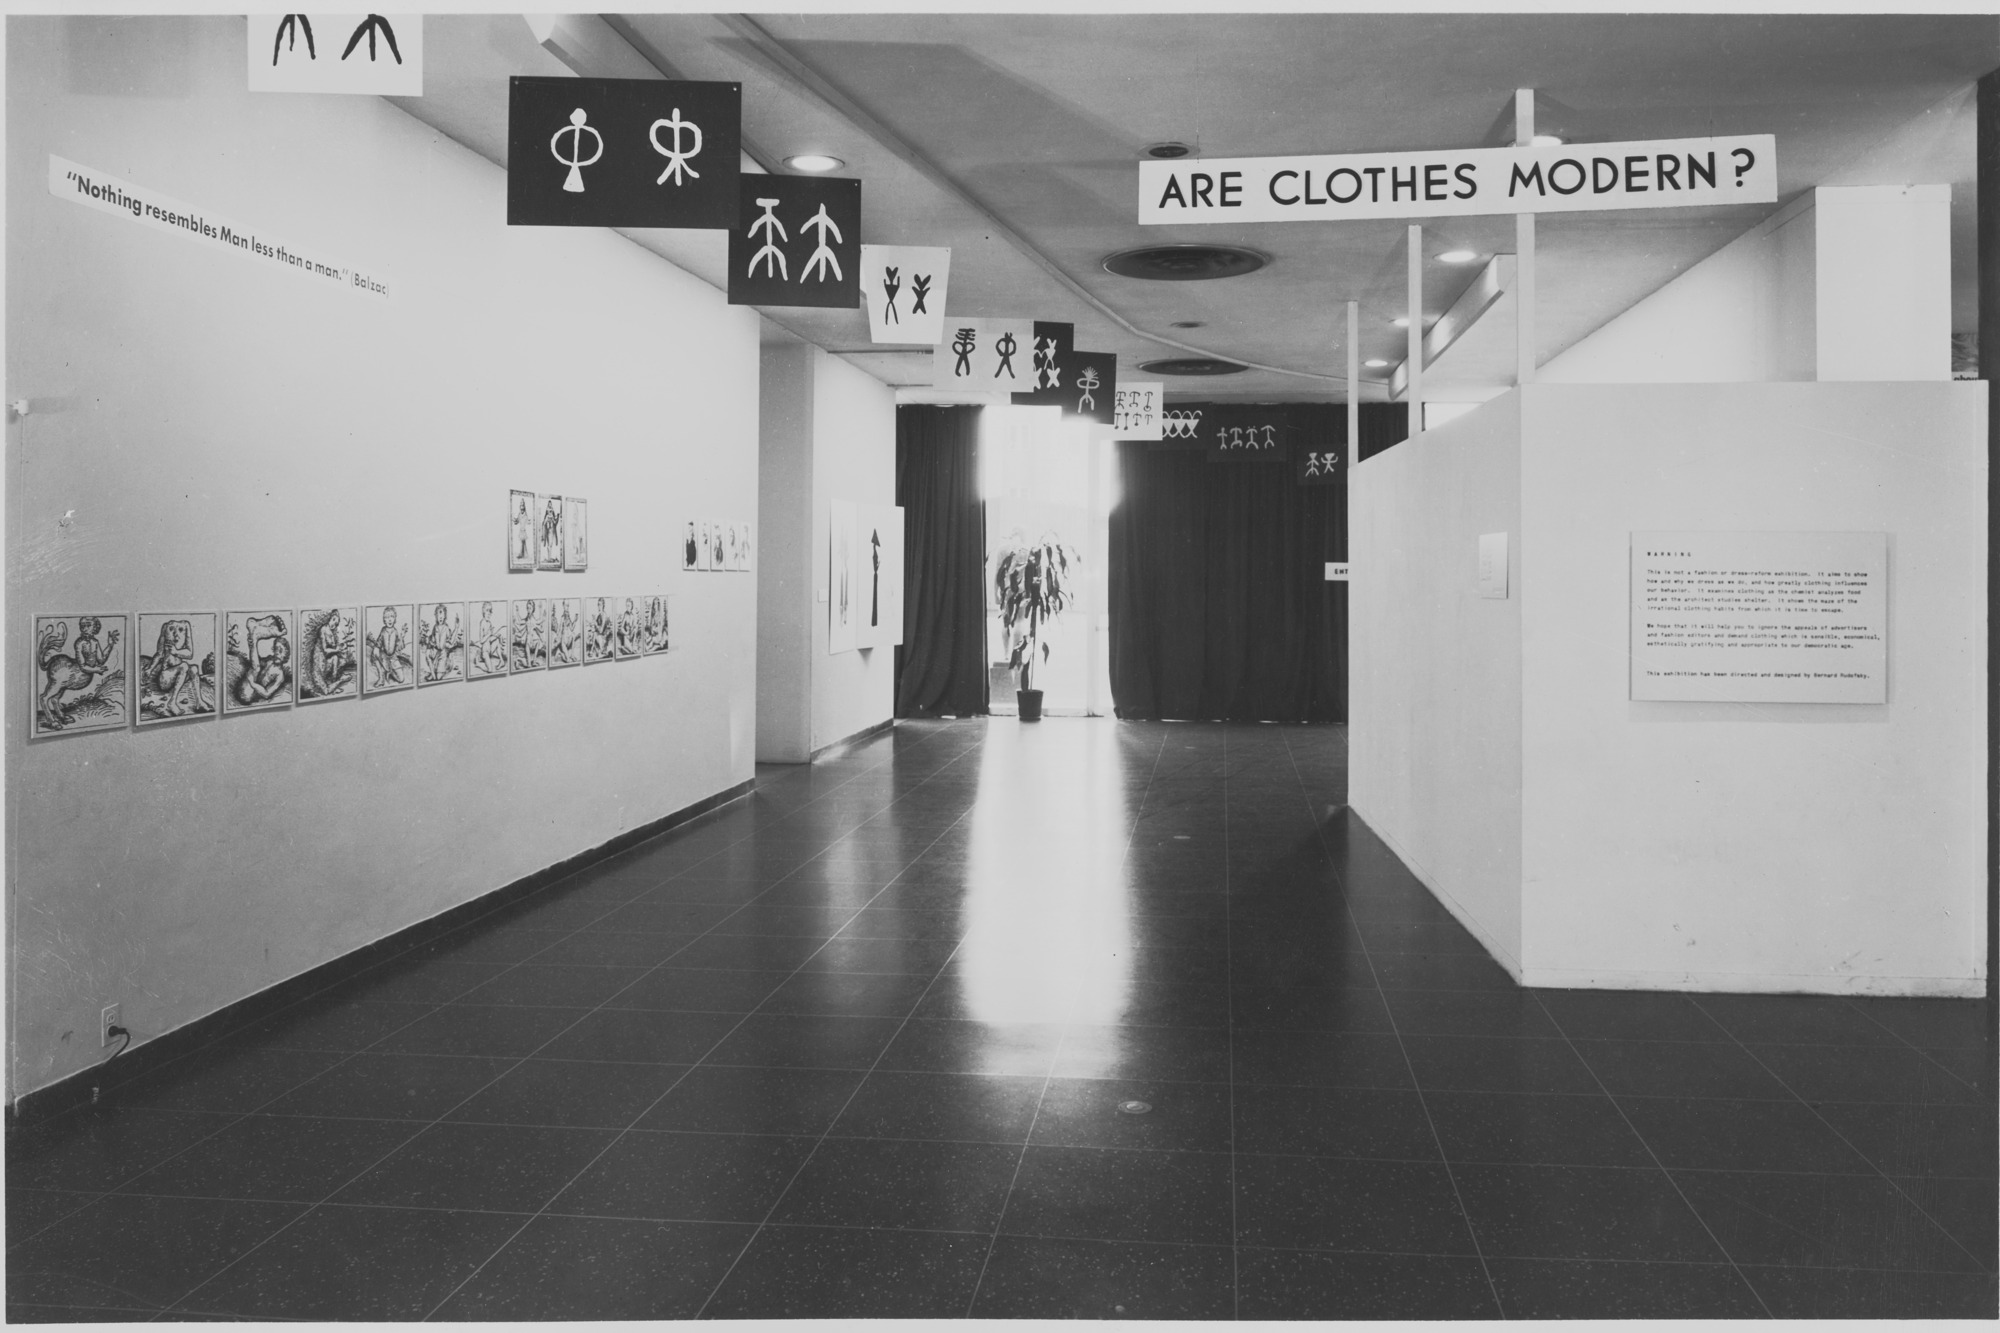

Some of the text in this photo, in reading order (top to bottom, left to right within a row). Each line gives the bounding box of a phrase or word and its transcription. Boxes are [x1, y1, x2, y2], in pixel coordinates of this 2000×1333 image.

[1158, 171, 1243, 208] ARE
[1268, 163, 1477, 205] CLOTHES
[66, 171, 142, 216] "Nothing
[146, 204, 217, 239] resembles
[220, 226, 248, 250] Man
[251, 236, 274, 258] less
[276, 246, 303, 268] than
[305, 260, 312, 271] a
[350, 271, 390, 299] (Balzac)
